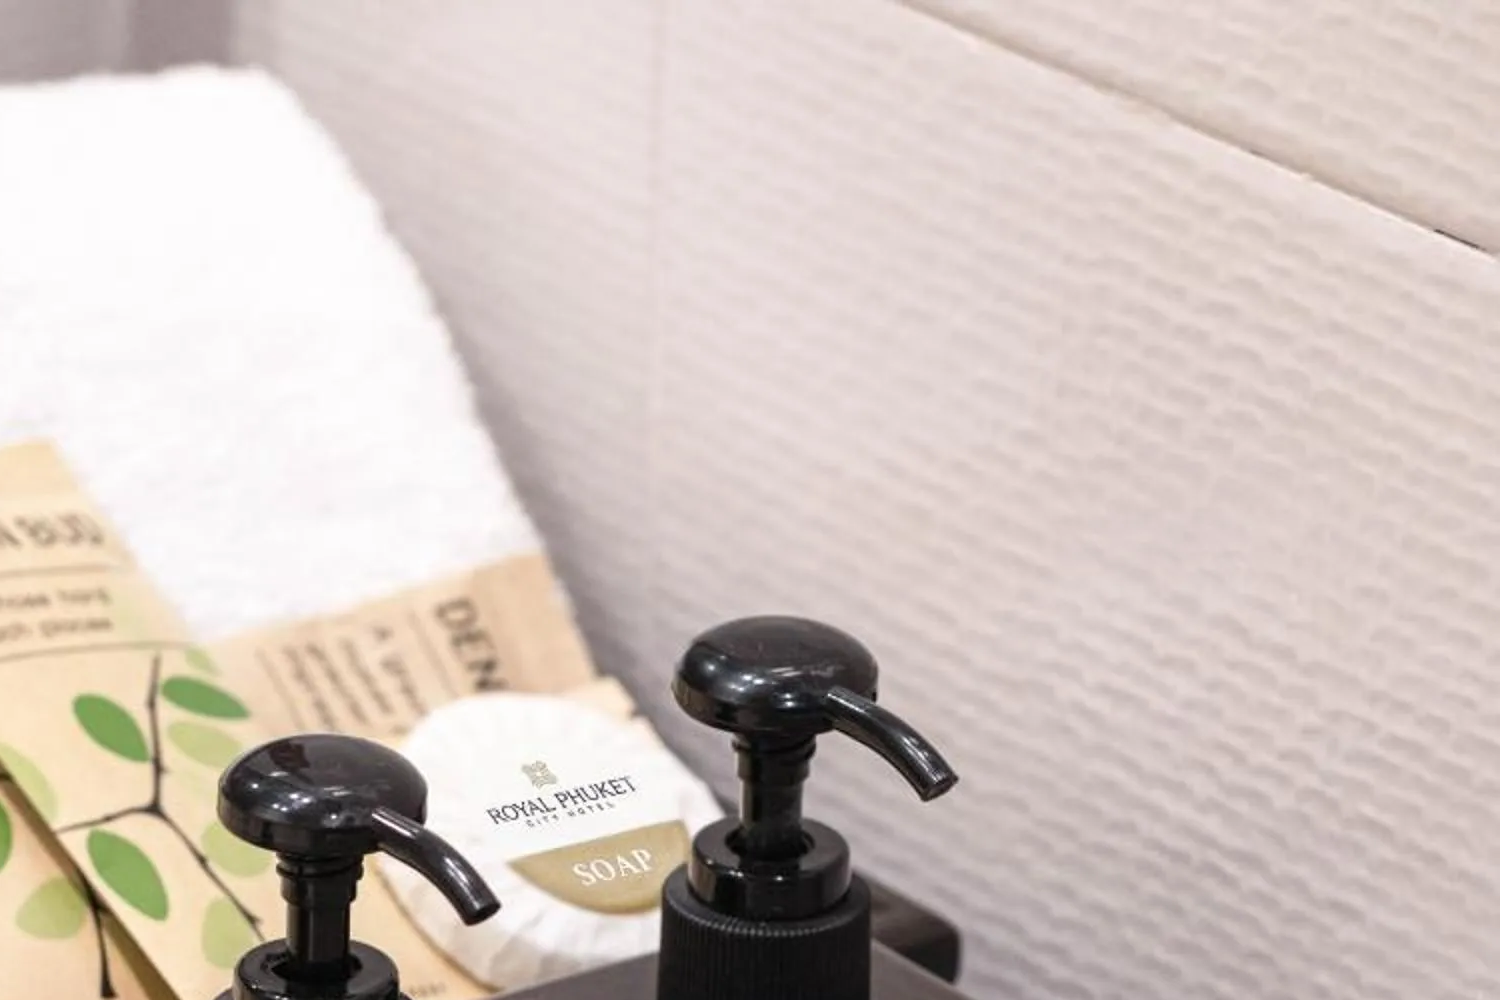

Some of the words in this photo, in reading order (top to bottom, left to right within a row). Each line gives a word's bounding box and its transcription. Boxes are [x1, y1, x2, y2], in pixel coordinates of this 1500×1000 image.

[14, 511, 105, 547] BUD
[434, 597, 510, 692] DEN
[486, 796, 557, 825] ROYAL
[554, 775, 637, 809] PHUKET
[572, 848, 653, 886] SOAP
